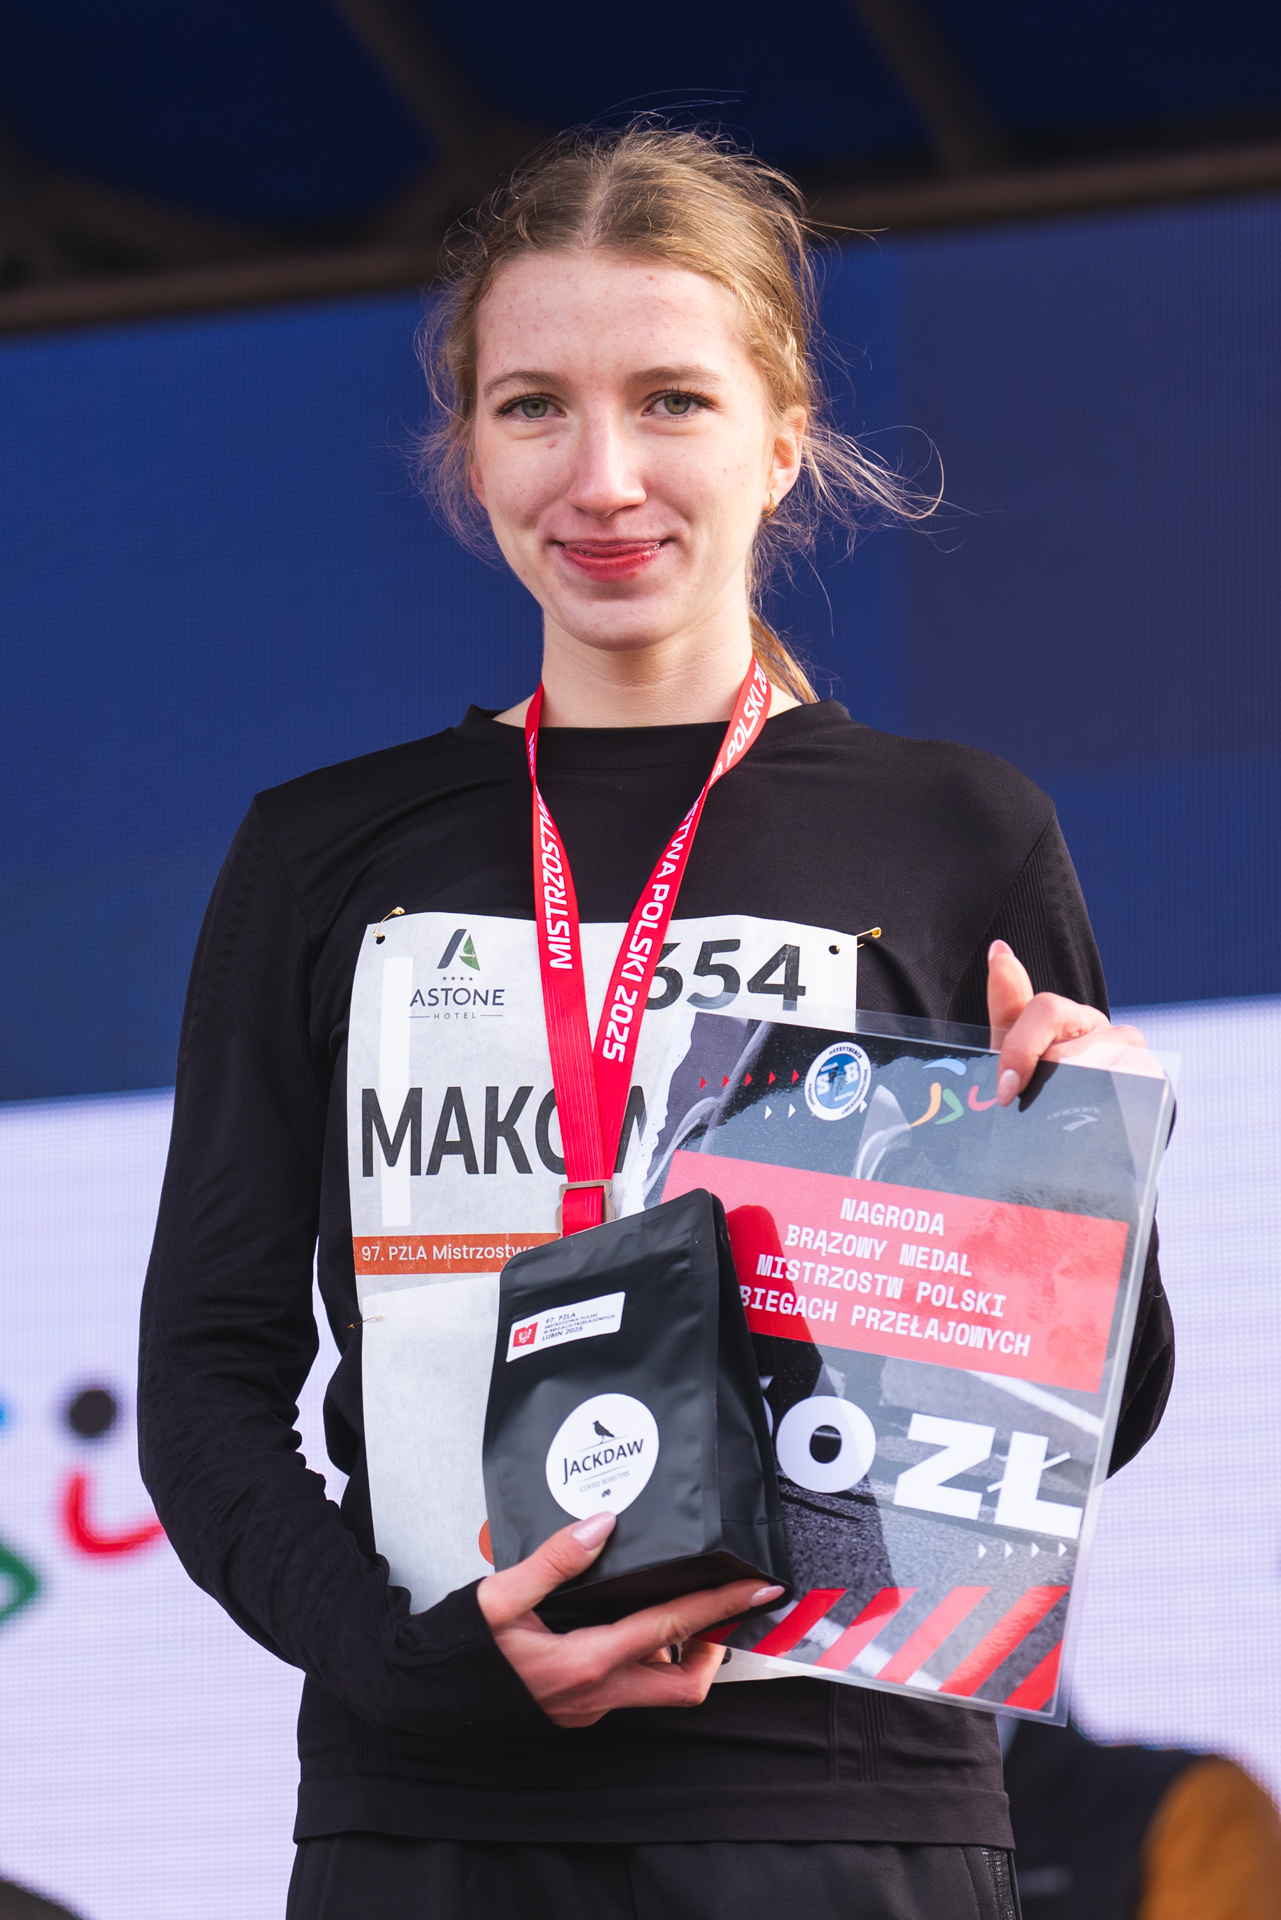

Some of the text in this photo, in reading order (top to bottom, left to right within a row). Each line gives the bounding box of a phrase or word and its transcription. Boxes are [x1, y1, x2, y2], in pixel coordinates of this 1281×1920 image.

[726, 682, 766, 768] POLSKI
[620, 883, 671, 983] POLSKI
[409, 987, 505, 1007] ASTONE
[644, 938, 807, 1012] 654
[433, 1011, 476, 1020] HOTEL
[602, 984, 639, 1064] 2025
[840, 1197, 945, 1237] NAGRODA
[361, 1245, 385, 1262] 97.
[388, 1245, 428, 1262] PZLA
[784, 1223, 973, 1277] BRĄZOWY MEDAL
[755, 1253, 1007, 1318] MISTRZOSTW POLSKI
[542, 1325, 584, 1341] LUBIN 2025
[740, 1284, 1032, 1357] BIEGACH PRZEŁAJOWYCH
[562, 1438, 645, 1486] JACKDAW
[579, 1470, 631, 1493] COFFEE ROASTERS
[892, 1412, 1084, 1540] ZŁ
